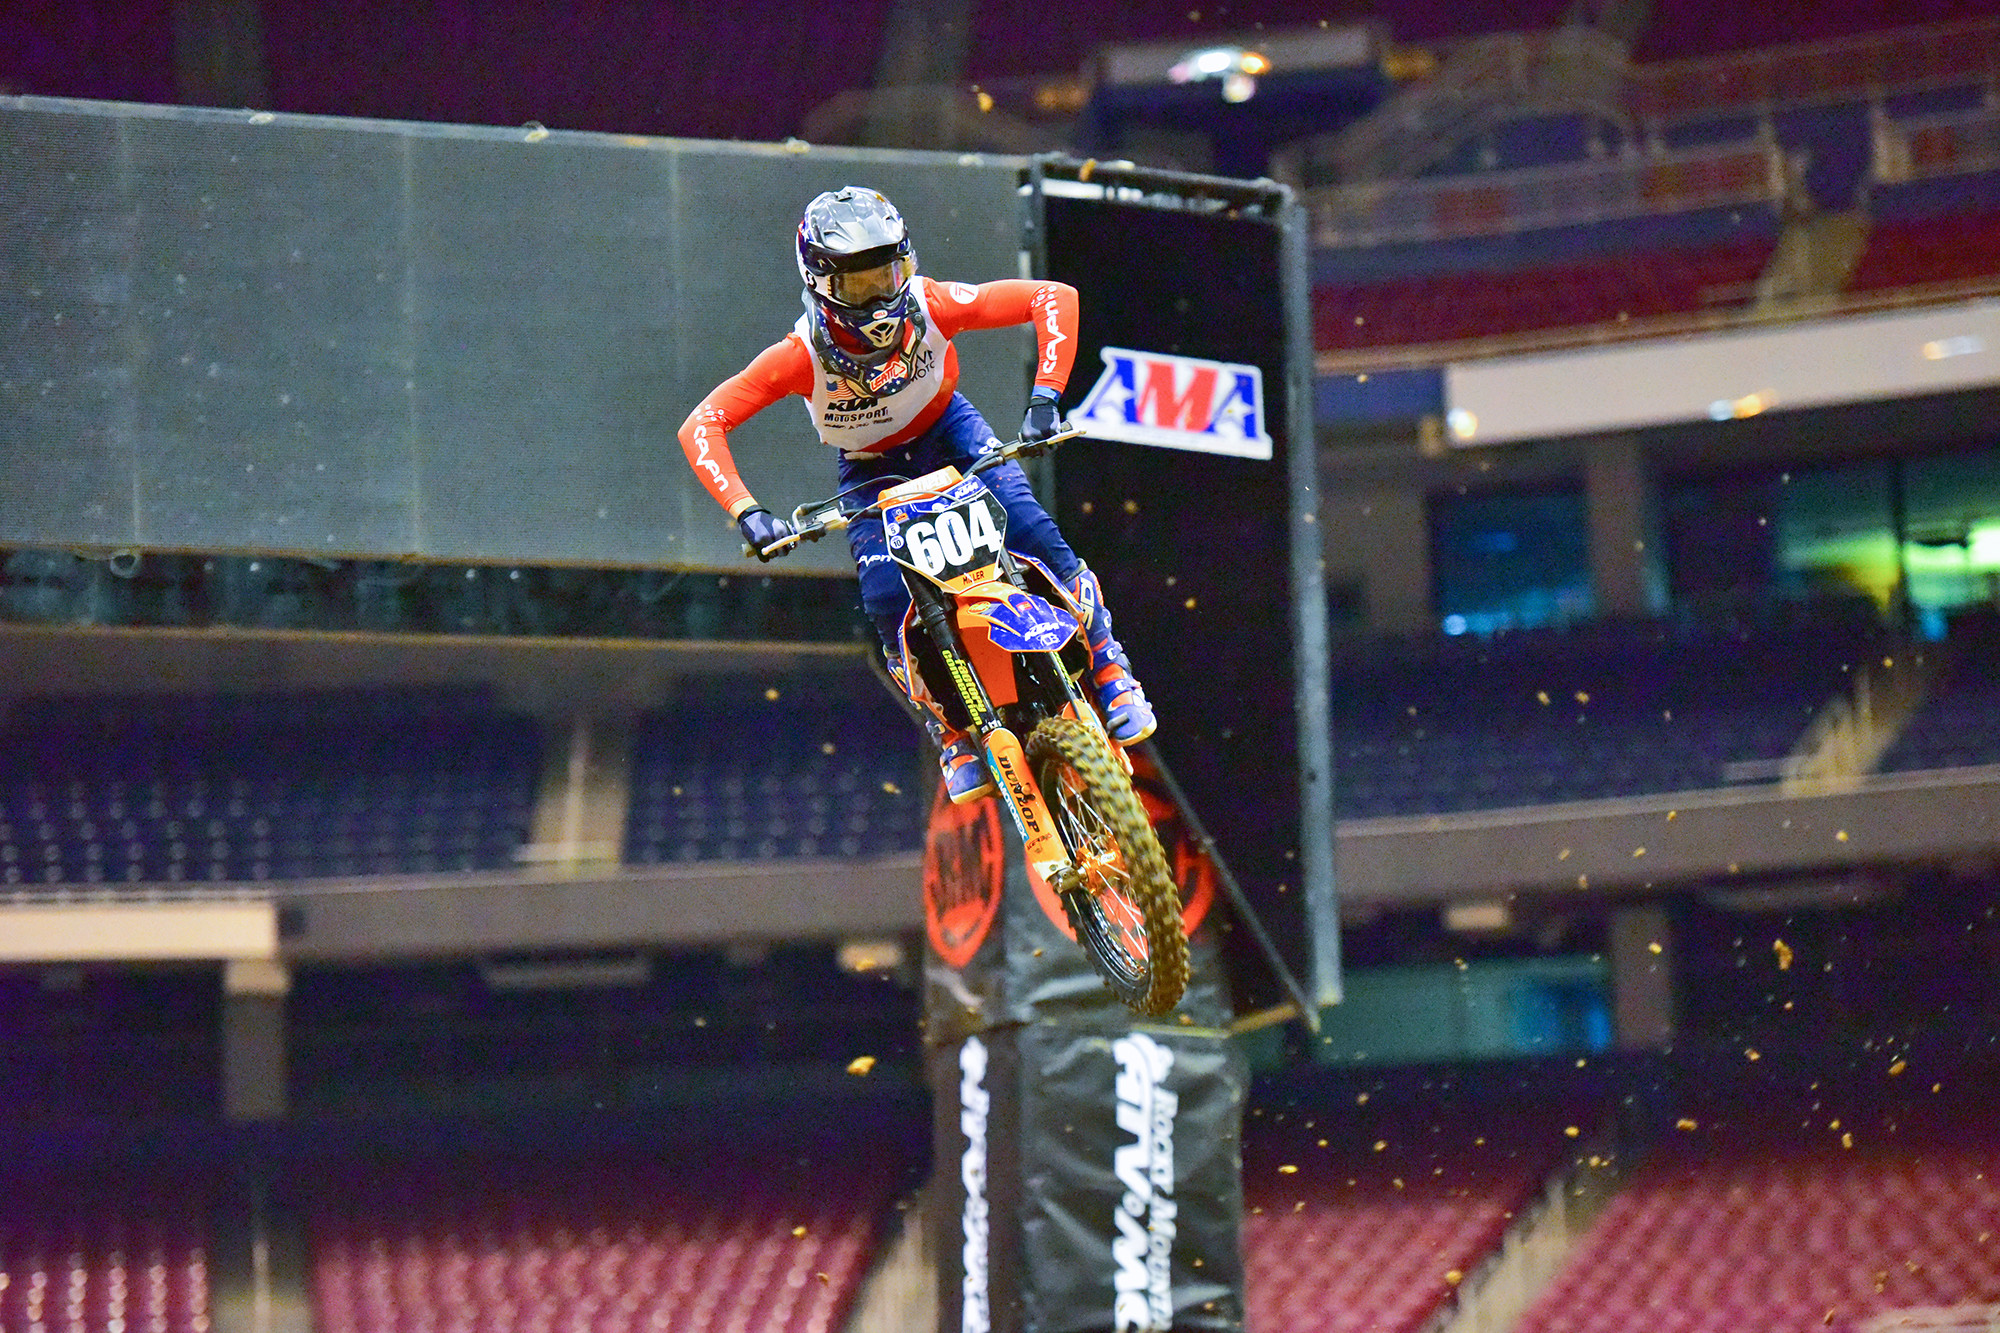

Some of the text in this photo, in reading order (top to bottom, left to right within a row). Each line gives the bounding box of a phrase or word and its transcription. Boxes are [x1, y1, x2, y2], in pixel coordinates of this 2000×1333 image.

[827, 397, 878, 411] KTM
[1081, 355, 1262, 441] AMA
[953, 481, 979, 499] KTM
[905, 499, 1002, 577] 604
[997, 755, 1040, 833] DUNLOP
[998, 781, 1028, 839] MOTOREX
